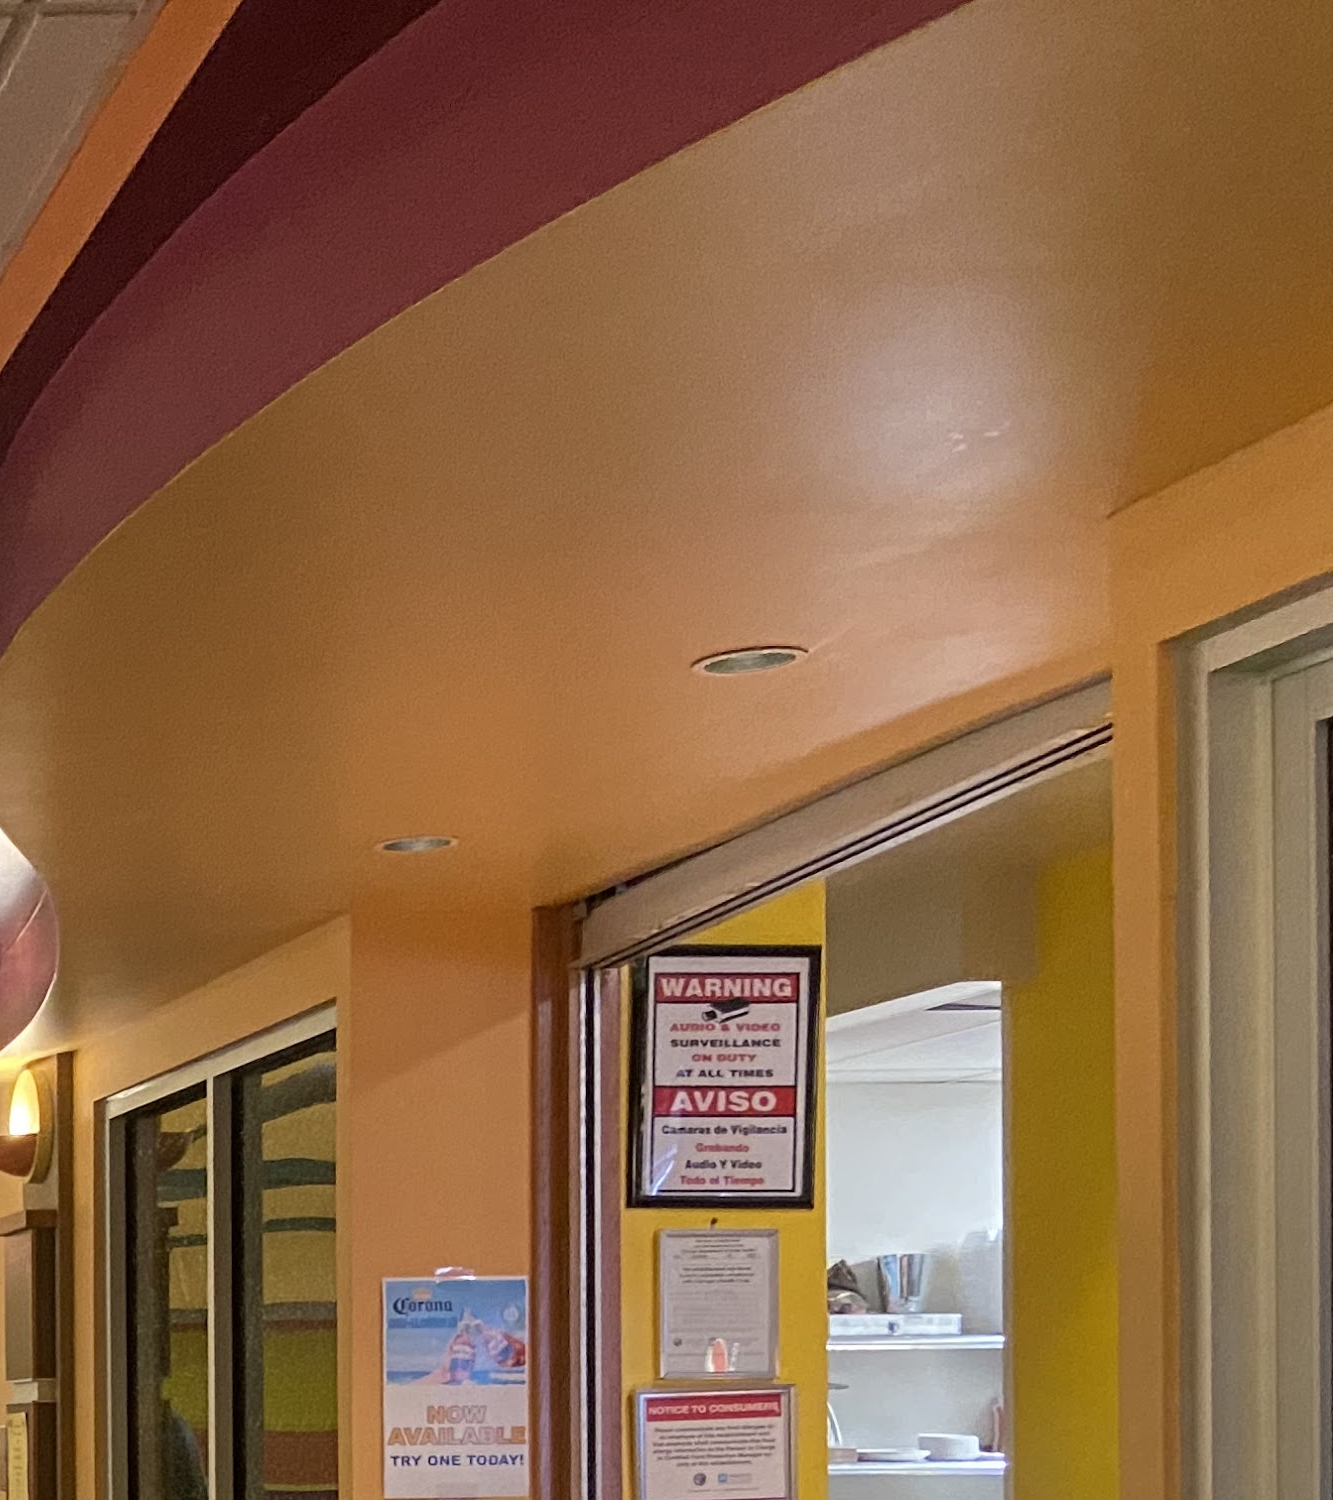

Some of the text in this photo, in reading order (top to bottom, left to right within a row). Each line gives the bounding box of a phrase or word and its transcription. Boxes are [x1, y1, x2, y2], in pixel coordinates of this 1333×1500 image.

[660, 977, 793, 998] WARNING
[669, 1022, 781, 1032] AUDIO & VIDEO
[669, 1038, 781, 1048] SURVEILLANCE
[691, 1053, 757, 1062] ON DUTY
[676, 1068, 774, 1078] AT ALL TIMES
[669, 1090, 778, 1112] AVISO
[714, 1124, 728, 1135] de
[730, 1124, 788, 1136] Vigilancia
[685, 1160, 716, 1170] Audio
[730, 1159, 762, 1170] Video
[392, 1297, 454, 1315] Corona
[426, 1404, 488, 1425] NOW
[648, 1404, 690, 1415] NOTICE
[691, 1404, 707, 1413] TO
[387, 1425, 527, 1446] AVAILABLE
[390, 1454, 524, 1467] TRY ONE TODAY!
